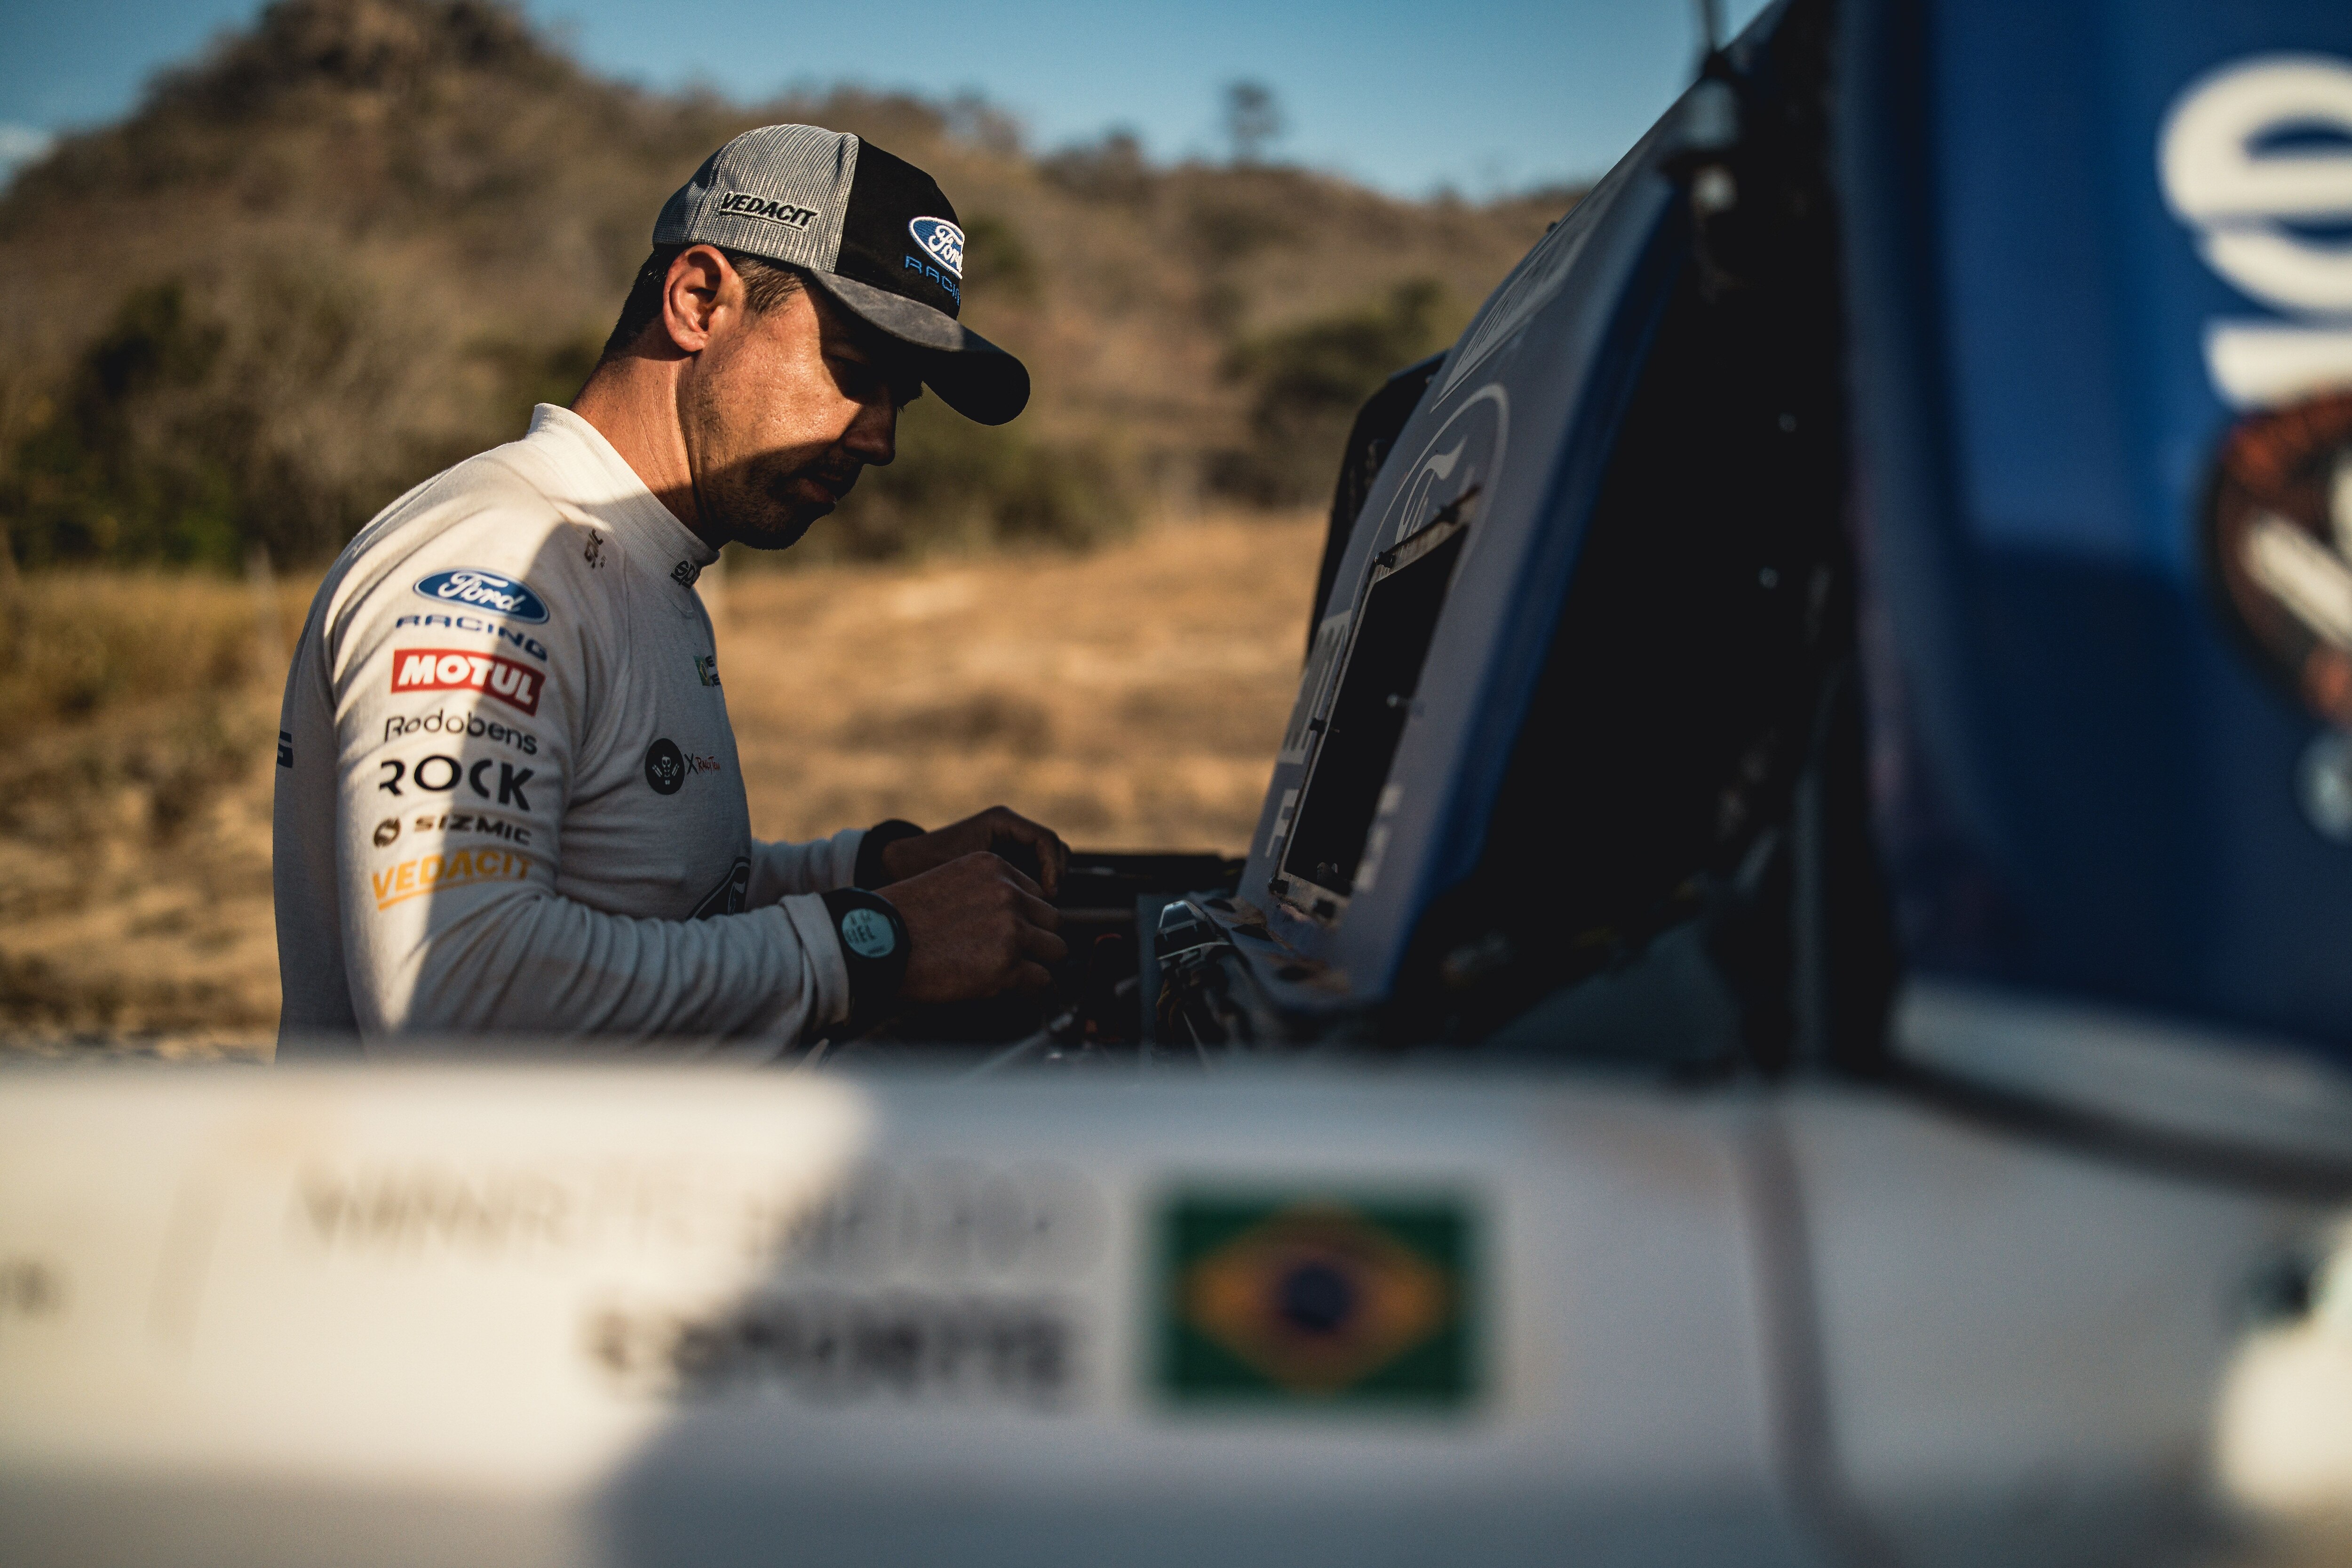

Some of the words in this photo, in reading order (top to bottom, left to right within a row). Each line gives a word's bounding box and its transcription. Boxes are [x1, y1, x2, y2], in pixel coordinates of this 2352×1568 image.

[721, 192, 818, 228] VEDACIT
[438, 571, 526, 612] Ford
[397, 614, 548, 662] RACING
[398, 654, 534, 706] MOTUL
[384, 708, 538, 756] Rodobens
[379, 755, 535, 812] ROCK
[414, 814, 532, 846] SIZMIC
[372, 850, 534, 901] VEDACIT
